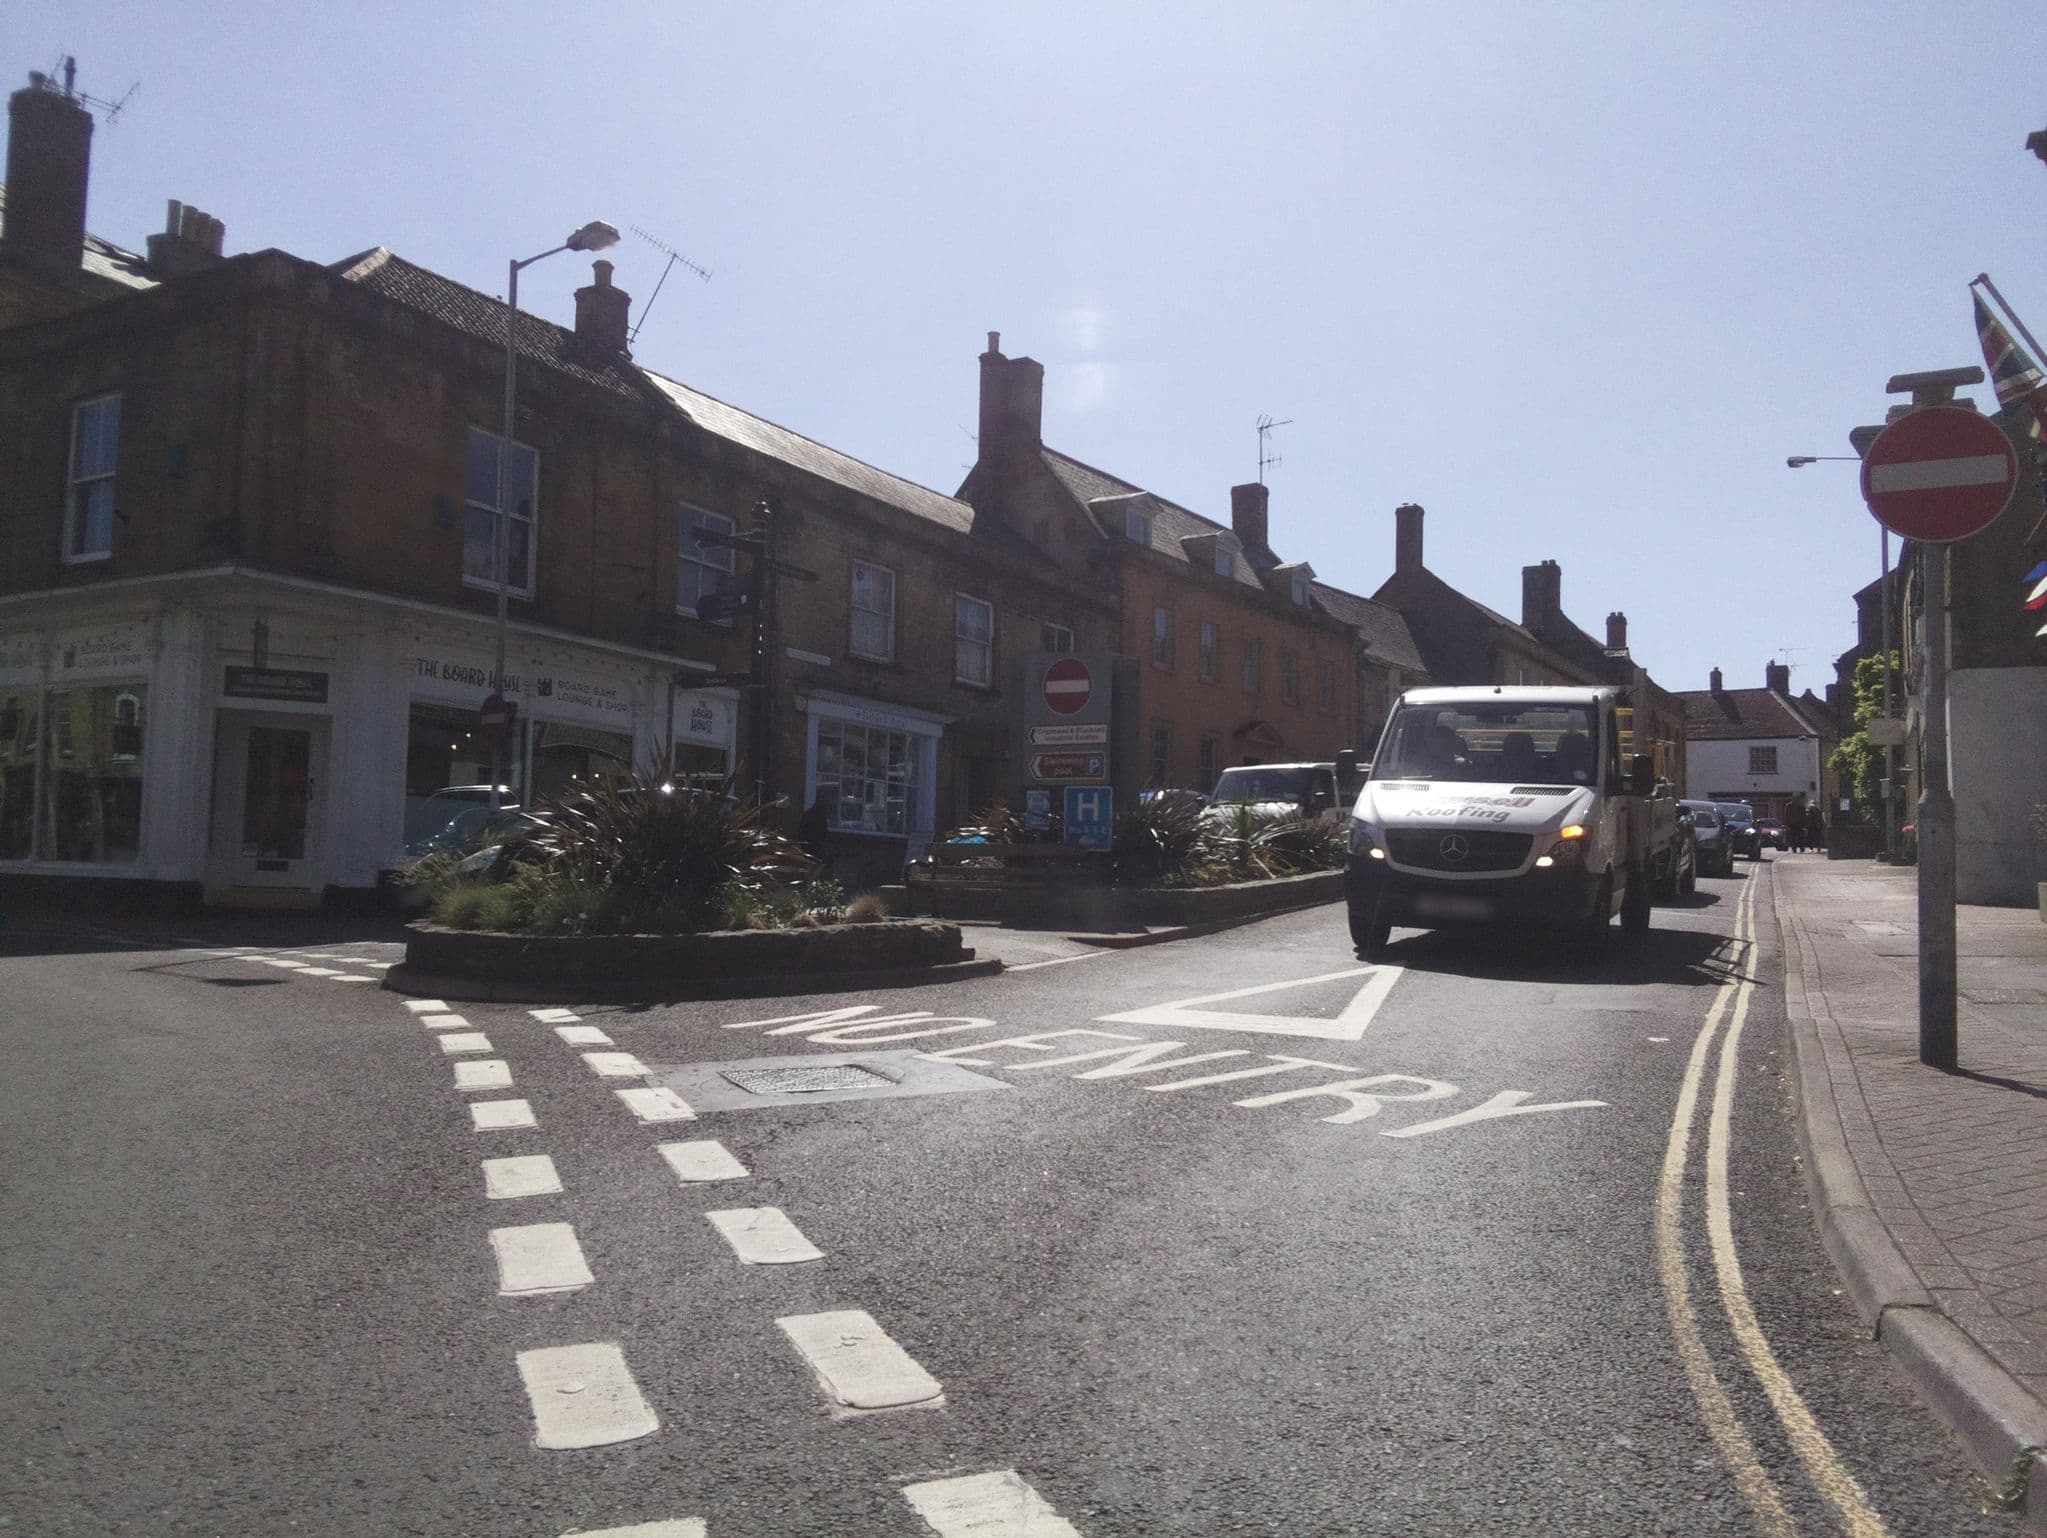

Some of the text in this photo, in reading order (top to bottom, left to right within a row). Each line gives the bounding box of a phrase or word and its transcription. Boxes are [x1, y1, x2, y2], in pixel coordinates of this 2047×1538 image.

[416, 657, 521, 692] THE BOARD HUSE
[558, 679, 617, 700] BOARD GAME
[557, 692, 593, 706] LOUNGE
[605, 701, 629, 713] SHOP
[1077, 791, 1100, 822] H
[720, 1005, 1609, 1138] NO ENTRY
